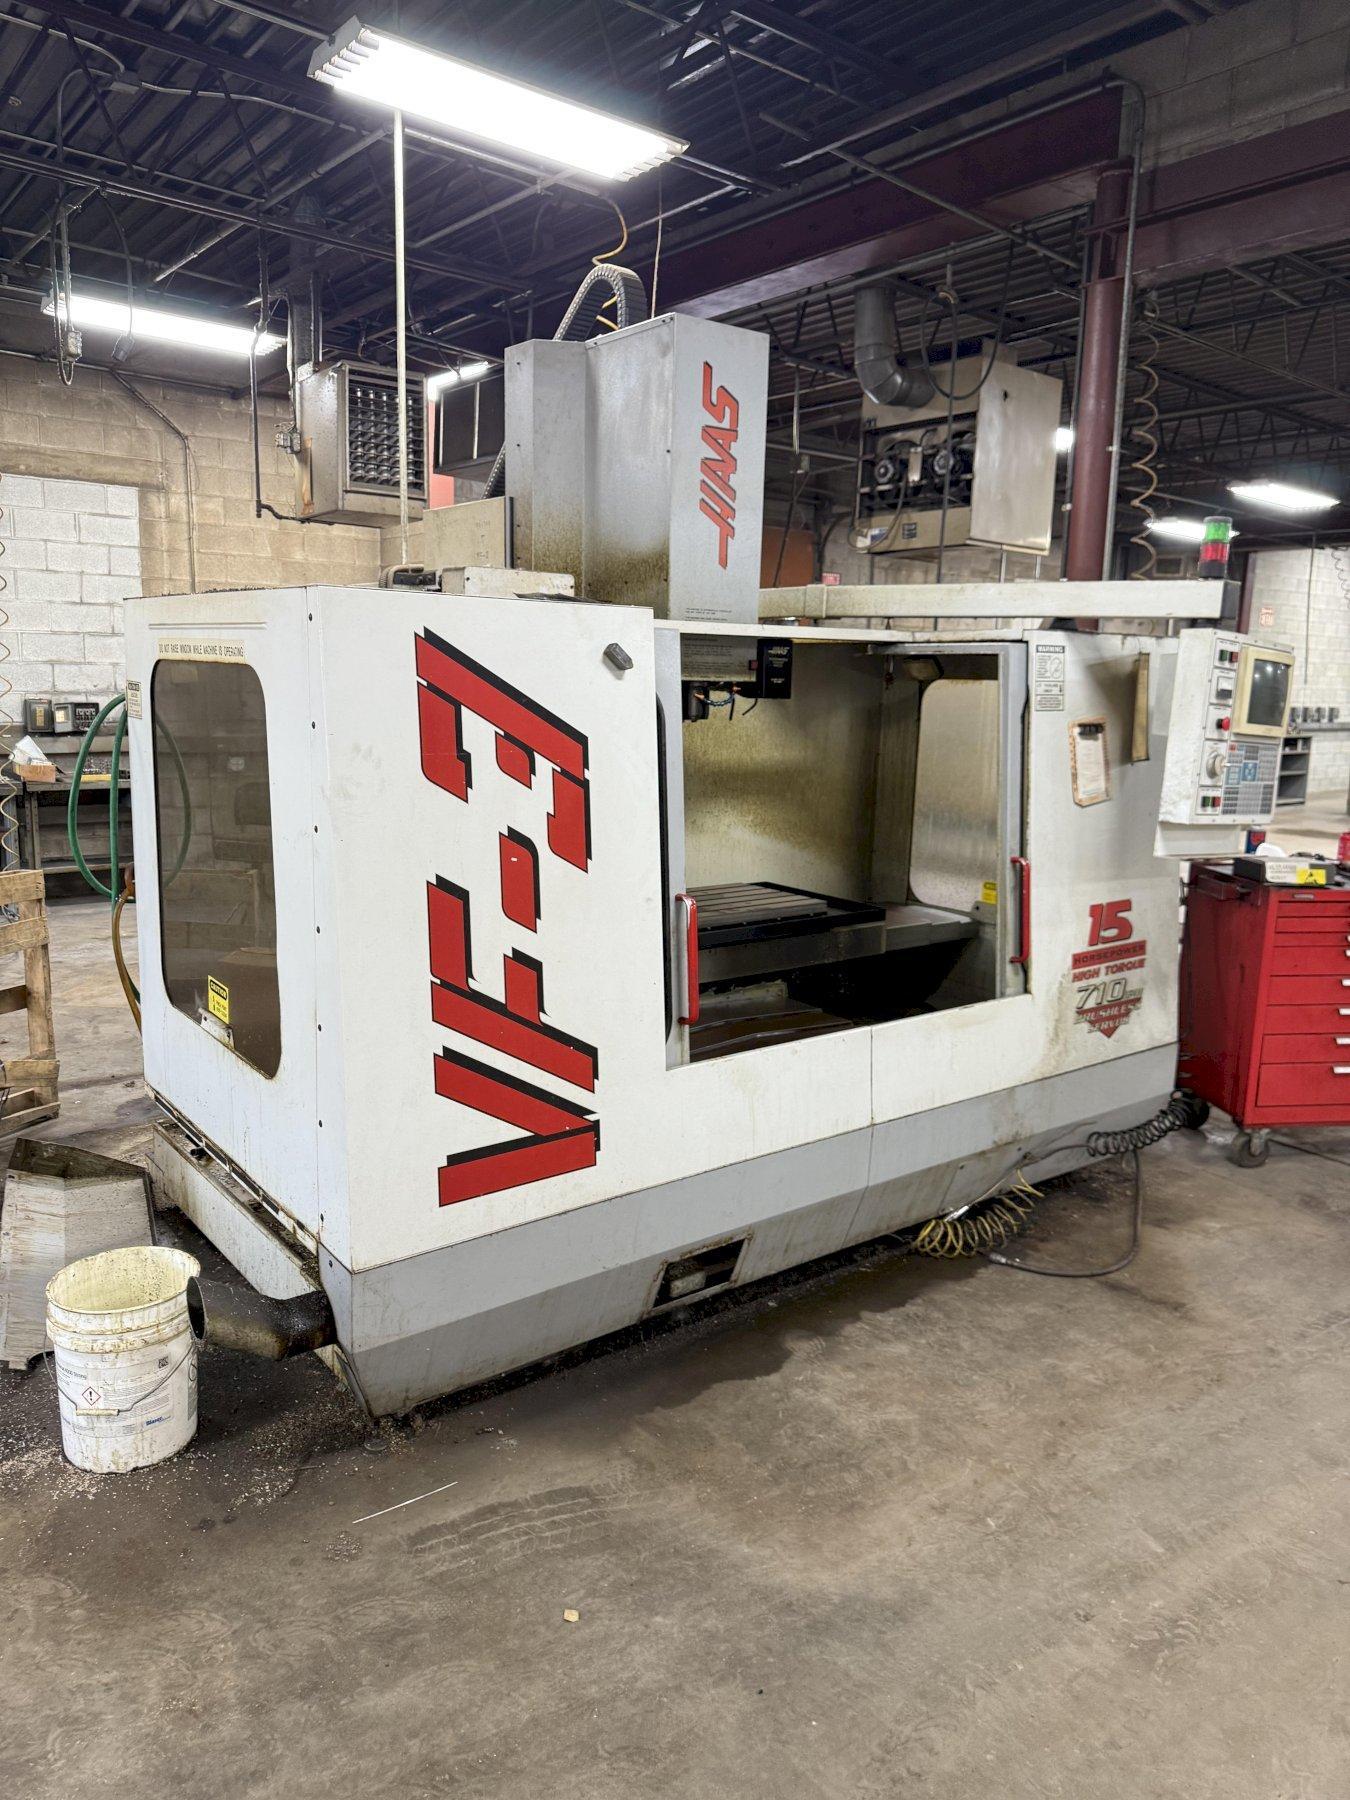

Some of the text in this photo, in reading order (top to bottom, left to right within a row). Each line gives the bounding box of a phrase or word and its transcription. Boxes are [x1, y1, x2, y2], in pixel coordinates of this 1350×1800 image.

[699, 360, 740, 570] HAAS
[1037, 645, 1063, 653] WARNING
[414, 625, 601, 1208] VF-3
[1087, 898, 1133, 947] 15
[1073, 943, 1145, 966] HORSEPOWER
[1072, 957, 1147, 983] HIGH TORQUE
[1075, 977, 1127, 1010] 710
[1073, 1002, 1141, 1025] BRUSHLESS
[1087, 1016, 1130, 1034] SERVOS
